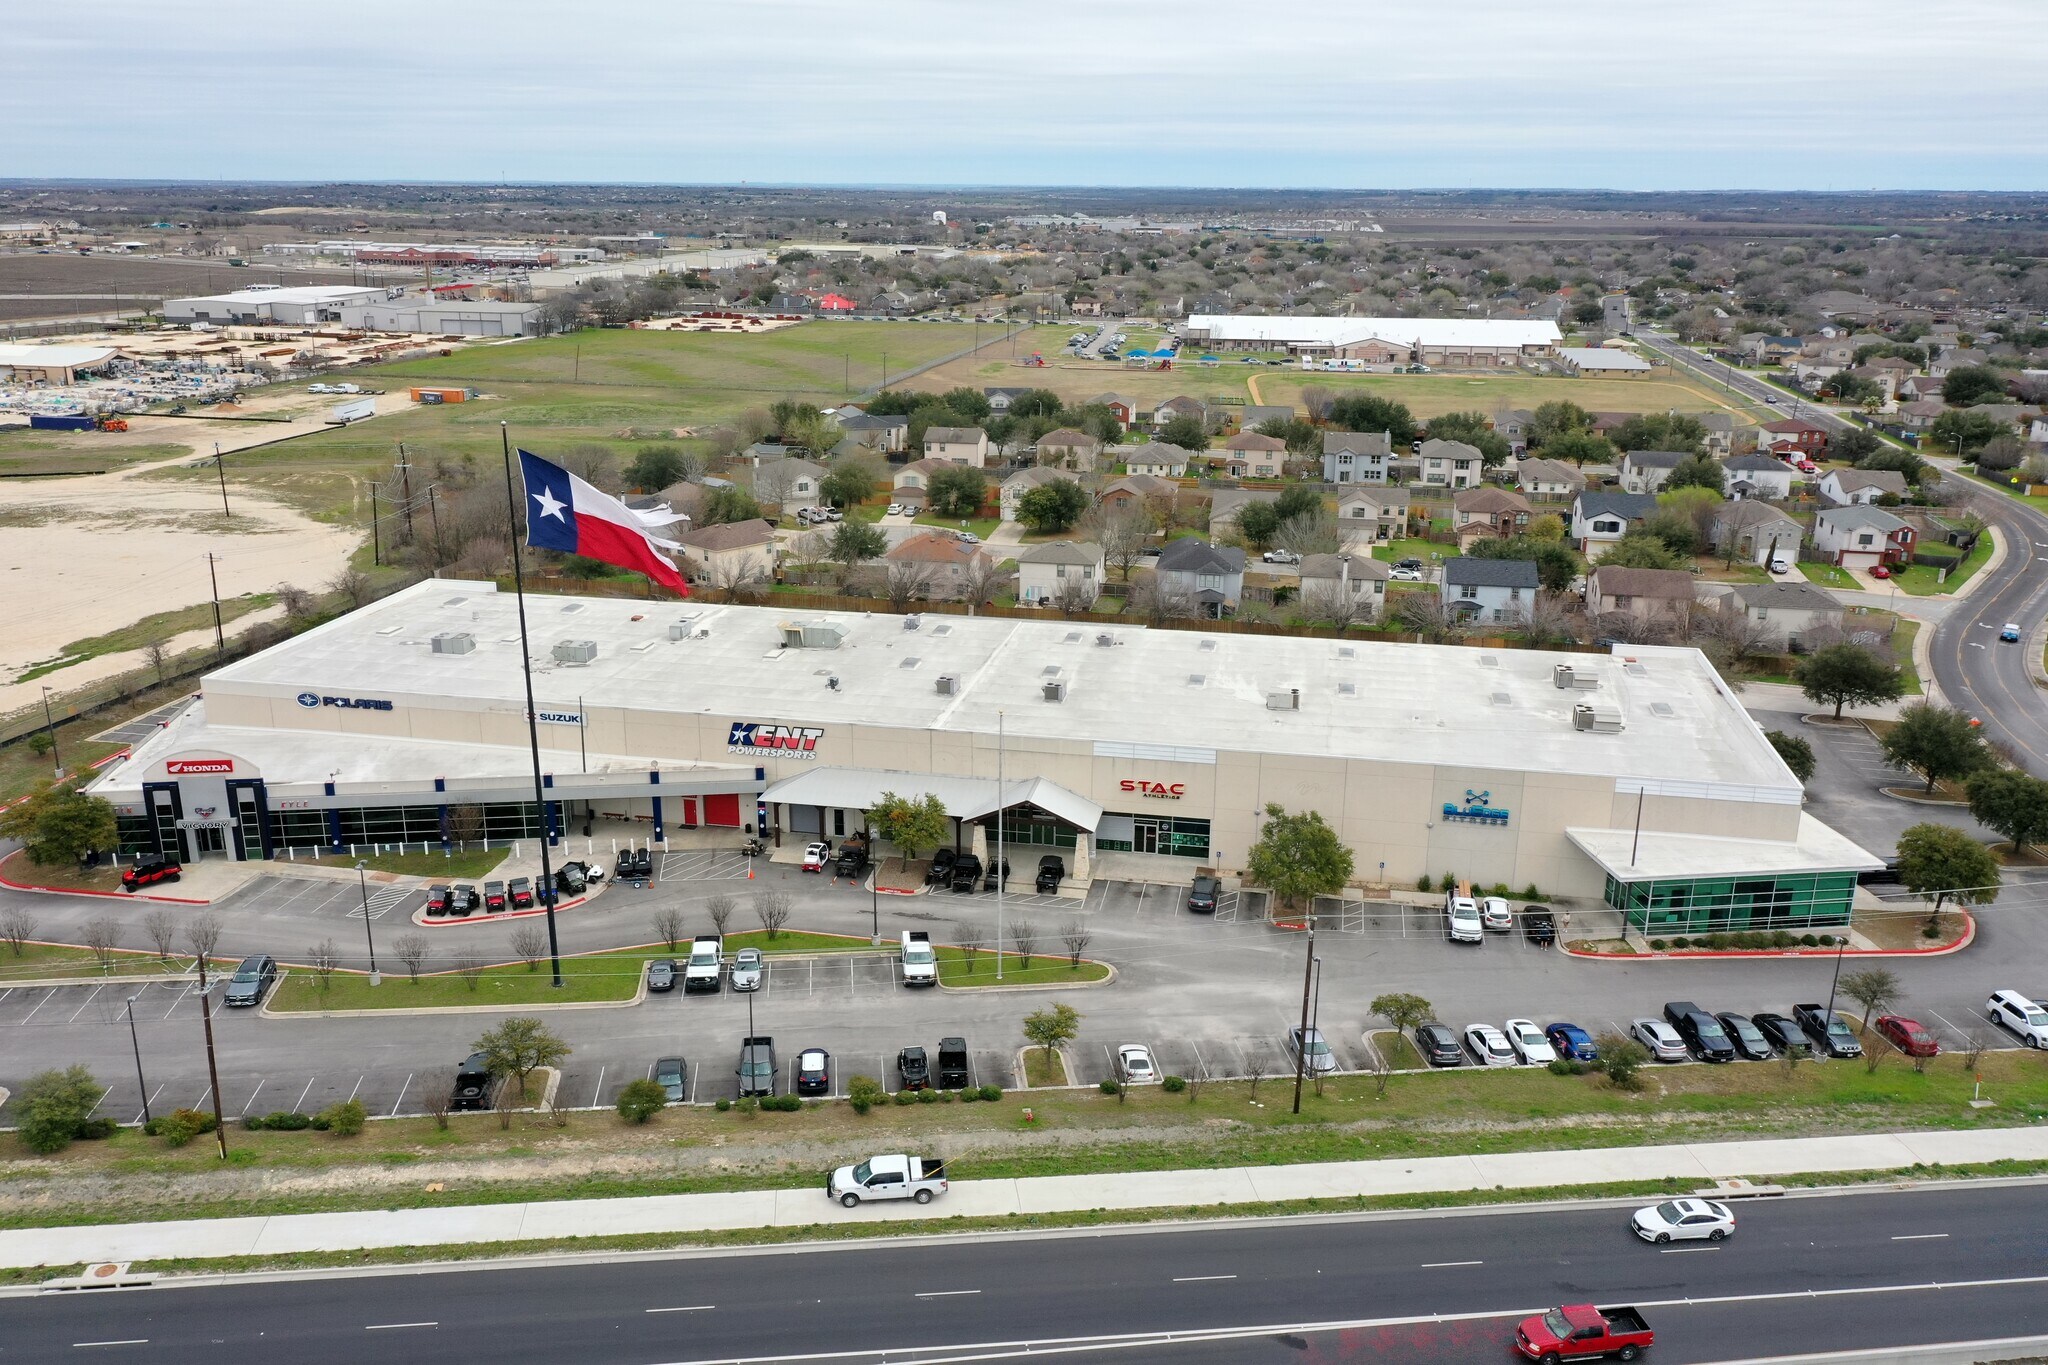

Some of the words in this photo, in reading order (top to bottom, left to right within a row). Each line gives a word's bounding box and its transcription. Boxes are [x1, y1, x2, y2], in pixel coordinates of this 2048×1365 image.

[322, 696, 393, 711] POLARIS
[727, 722, 824, 751] KENT
[727, 745, 817, 760] POWERSPORTS
[183, 764, 231, 772] HONDA
[1119, 780, 1185, 795] STAC
[181, 821, 229, 829] VICTORY
[1442, 815, 1508, 826] FITNESS
